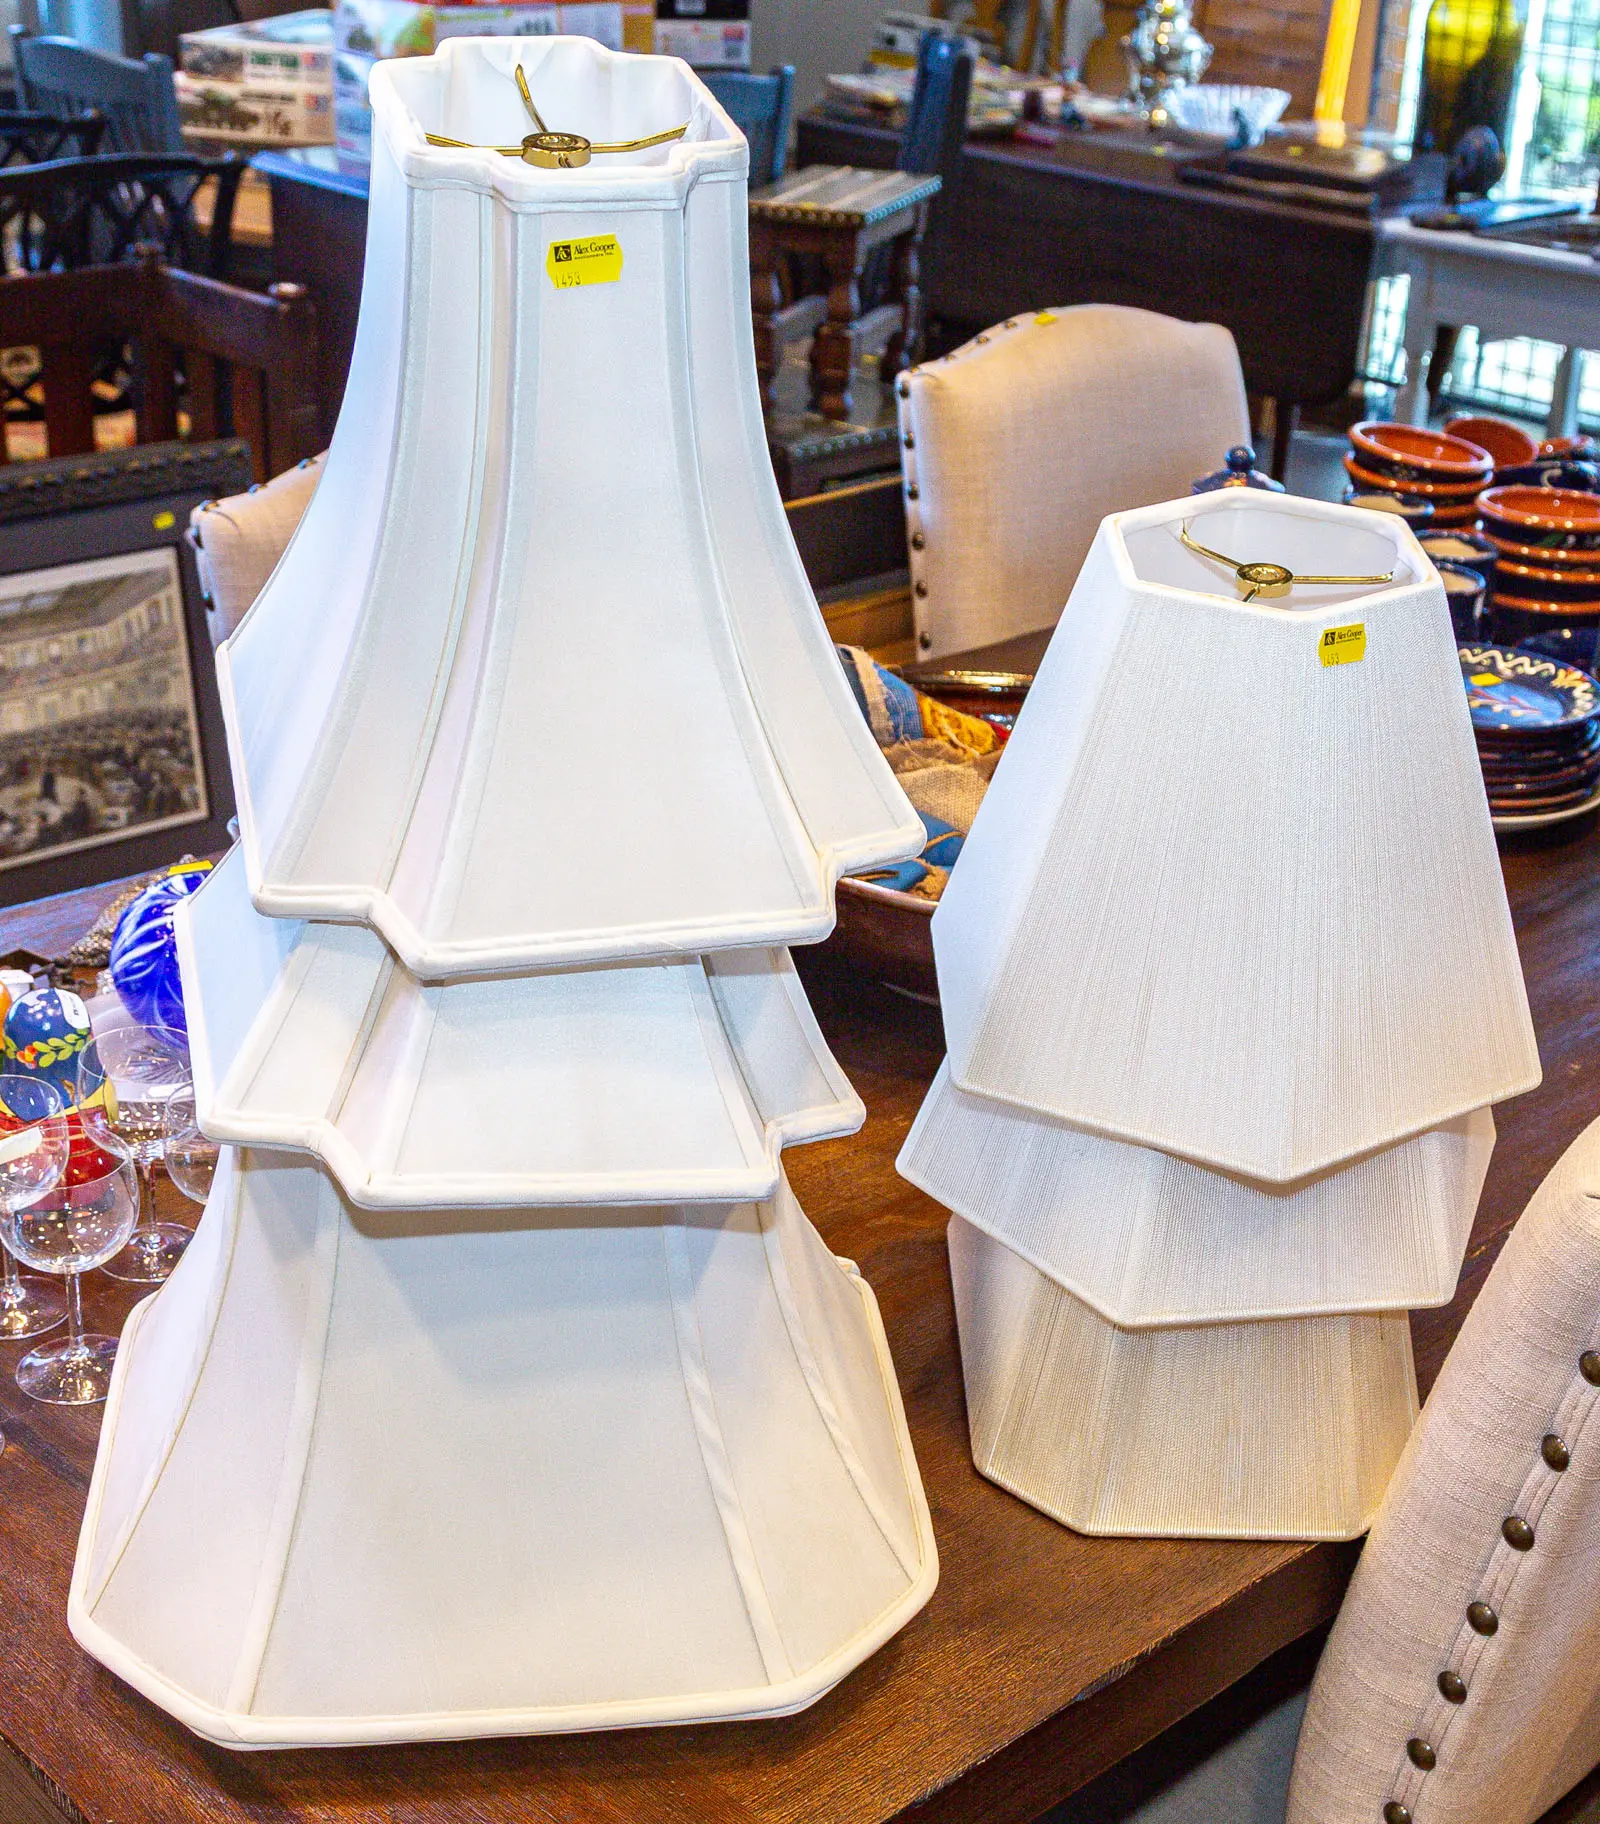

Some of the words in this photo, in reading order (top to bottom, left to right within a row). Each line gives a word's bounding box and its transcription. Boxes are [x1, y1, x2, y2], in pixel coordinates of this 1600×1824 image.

[574, 244, 589, 255] Alex
[589, 242, 616, 253] Cooper
[1346, 629, 1363, 638] Cooper
